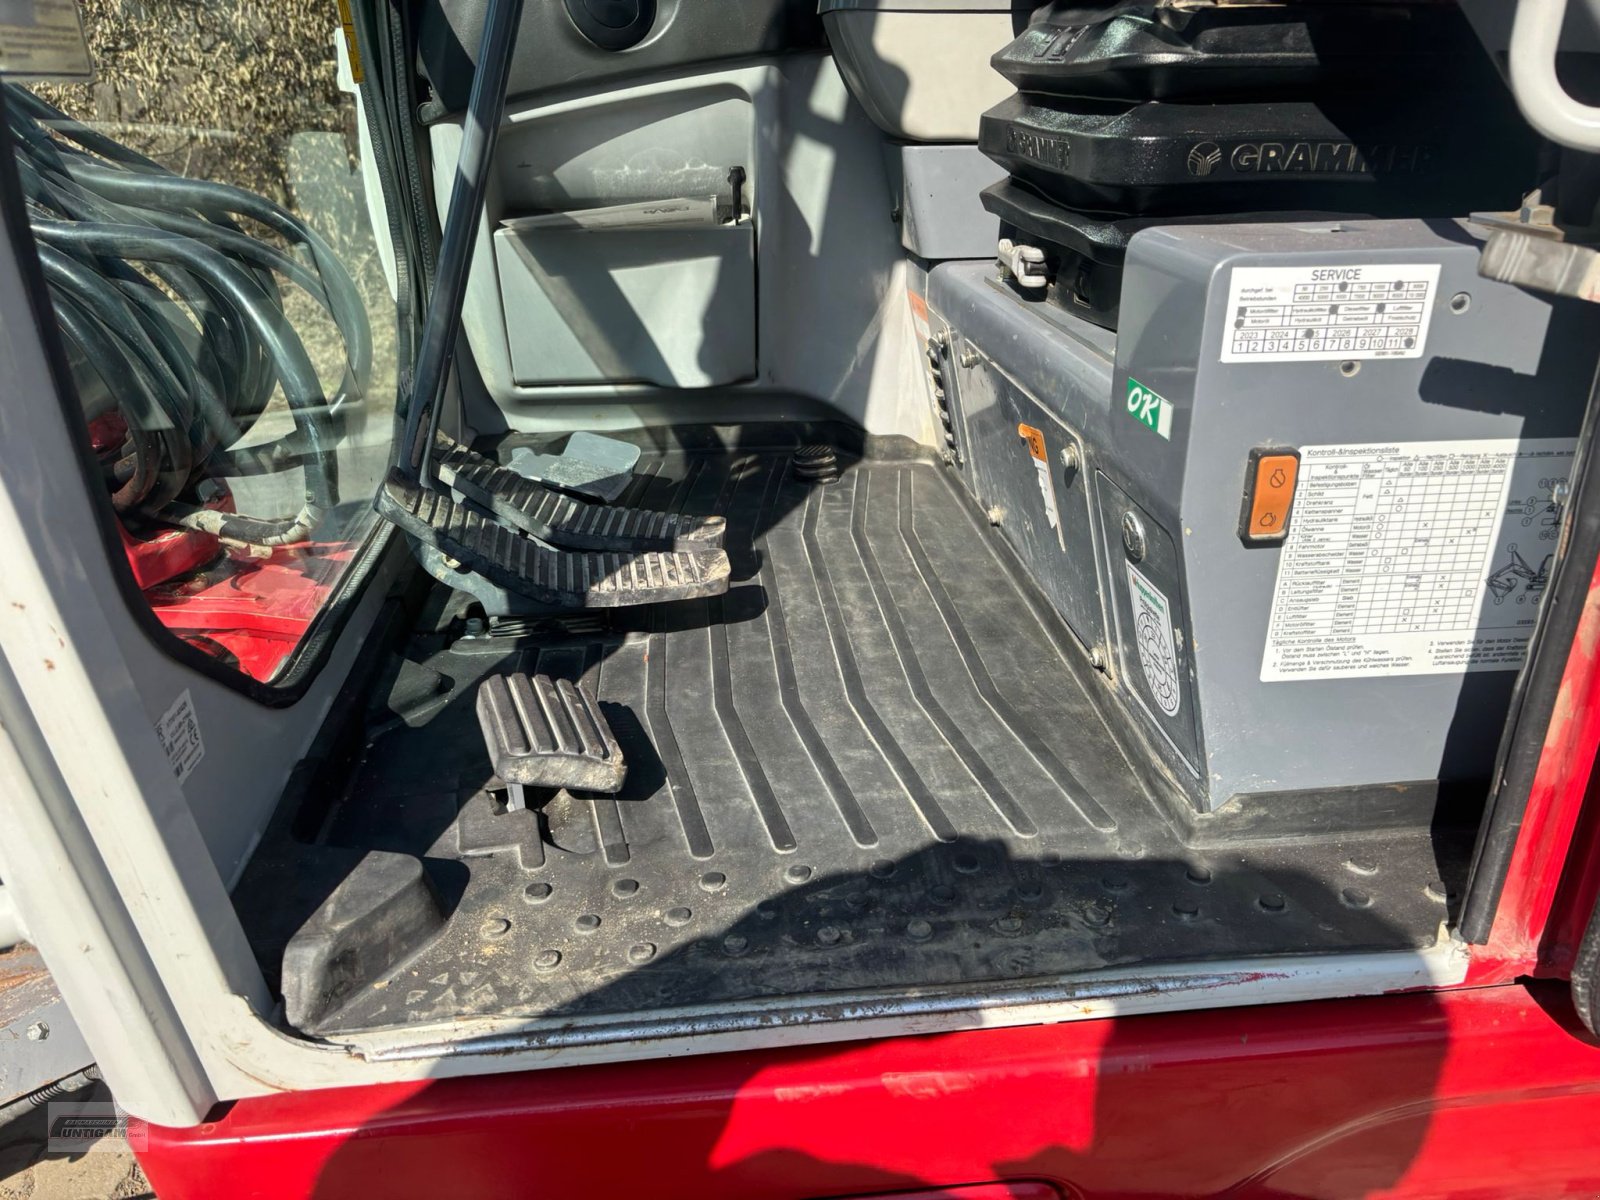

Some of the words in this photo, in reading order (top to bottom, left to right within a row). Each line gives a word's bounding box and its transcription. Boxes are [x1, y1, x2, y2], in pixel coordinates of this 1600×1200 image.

[1231, 142, 1437, 175] GRAMMER
[1311, 268, 1362, 281] SERVICE
[1251, 342, 1258, 351] 2
[1268, 342, 1274, 350] 3
[1282, 342, 1289, 350] 4
[1298, 341, 1305, 350] 5
[1313, 341, 1319, 349] 6
[1329, 340, 1335, 348] 7
[1344, 340, 1350, 348] 8
[1360, 340, 1366, 348] 9
[1372, 339, 1383, 348] 10
[1389, 339, 1398, 347] 11
[1128, 387, 1159, 425] OK
